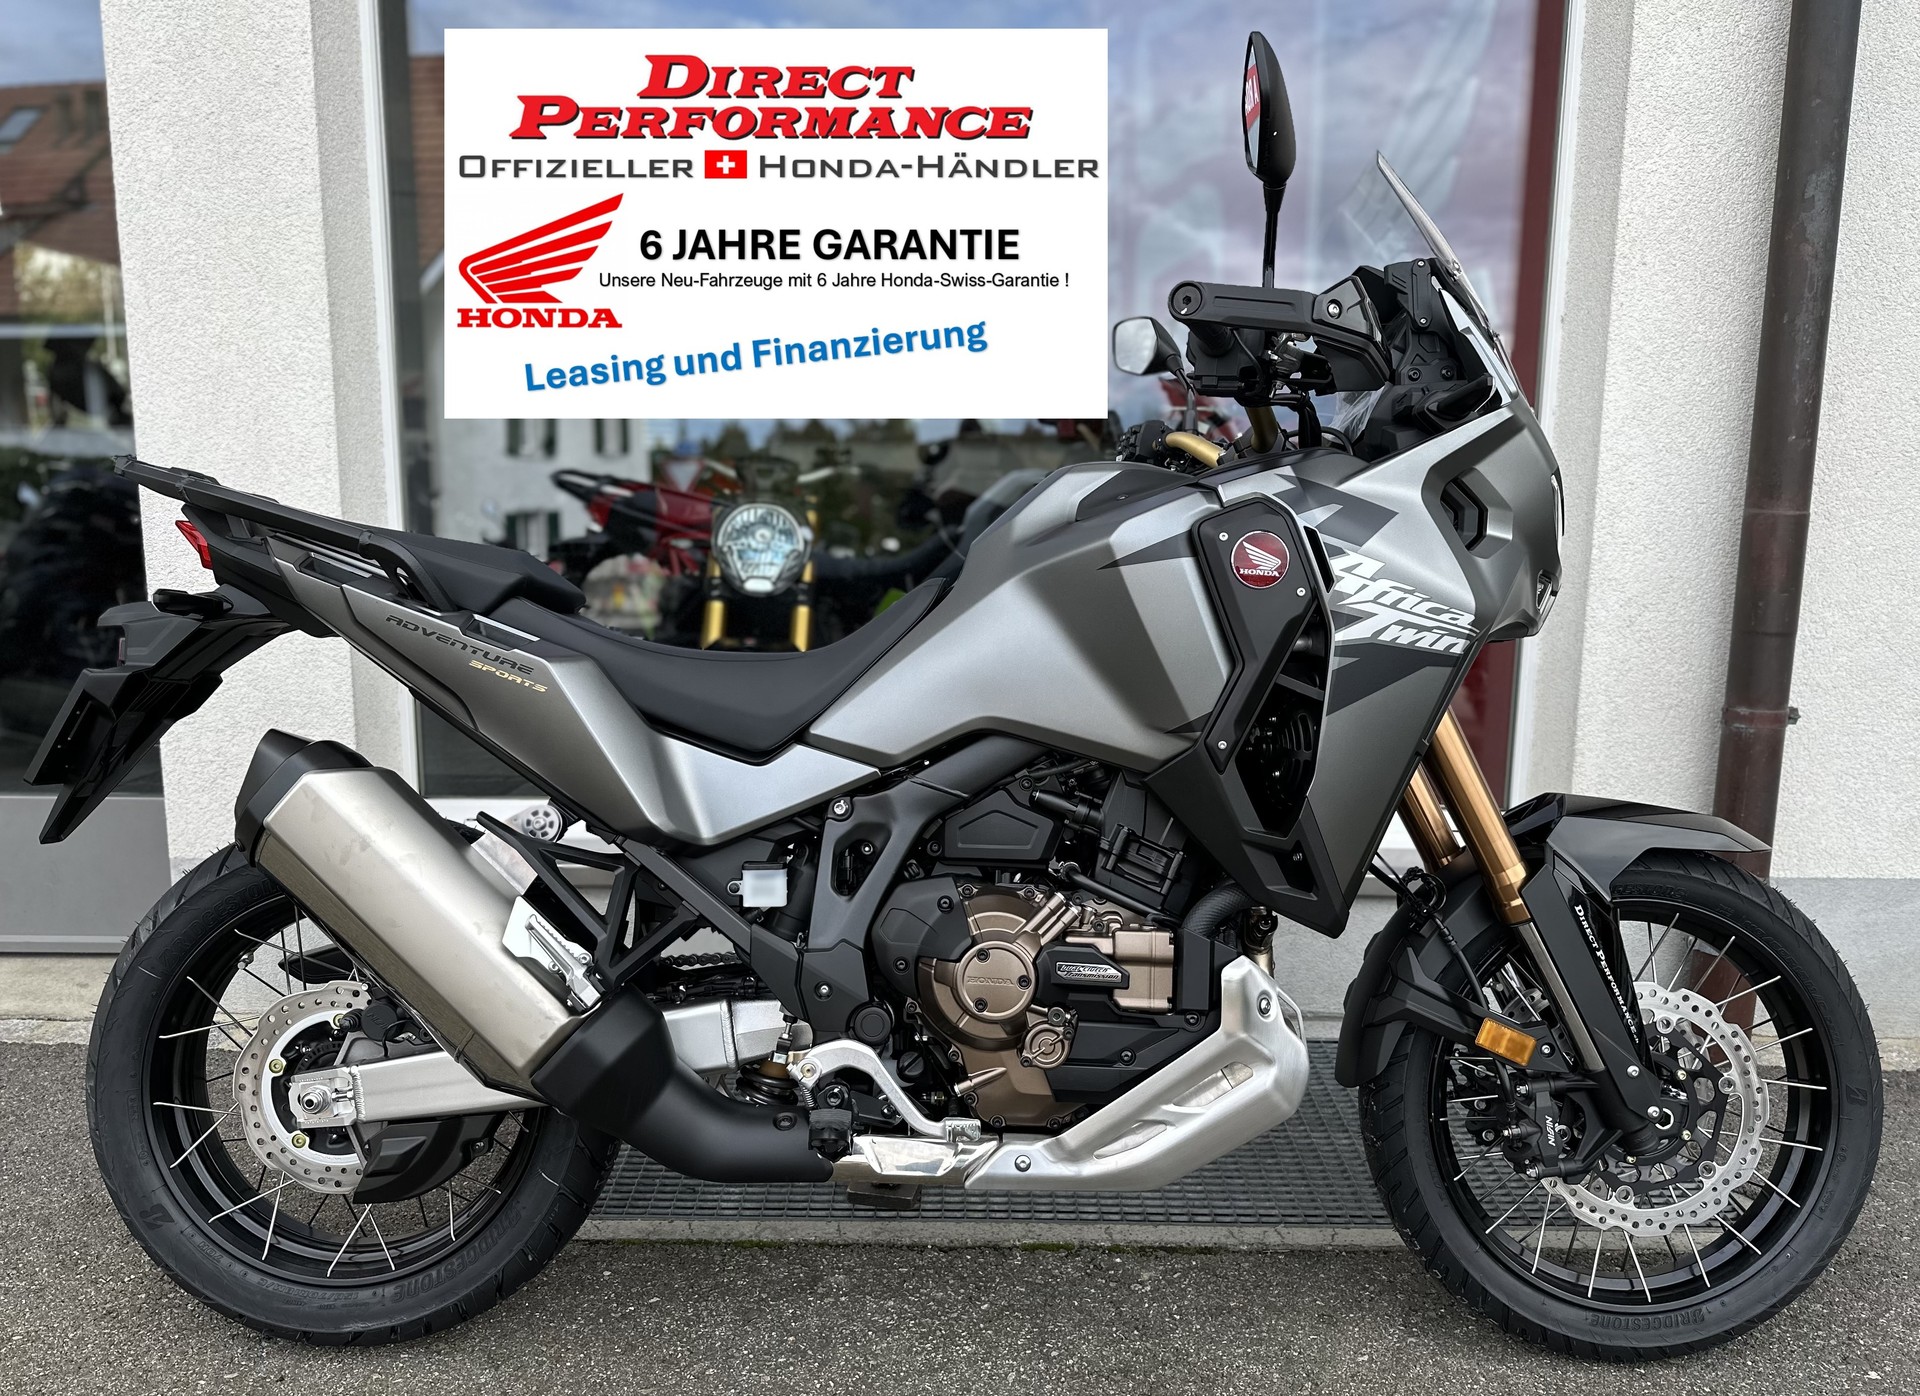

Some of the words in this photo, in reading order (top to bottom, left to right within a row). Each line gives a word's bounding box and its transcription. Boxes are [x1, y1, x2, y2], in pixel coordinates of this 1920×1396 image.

[1239, 568, 1280, 577] HONDA
[1331, 550, 1476, 628] Africa
[386, 614, 535, 675] ADVENTURE
[469, 659, 548, 693] SPORTS
[1574, 904, 1599, 949] DIRECT
[967, 976, 1015, 986] HONDA
[1590, 1308, 1705, 1331] BRIDGESTONE
